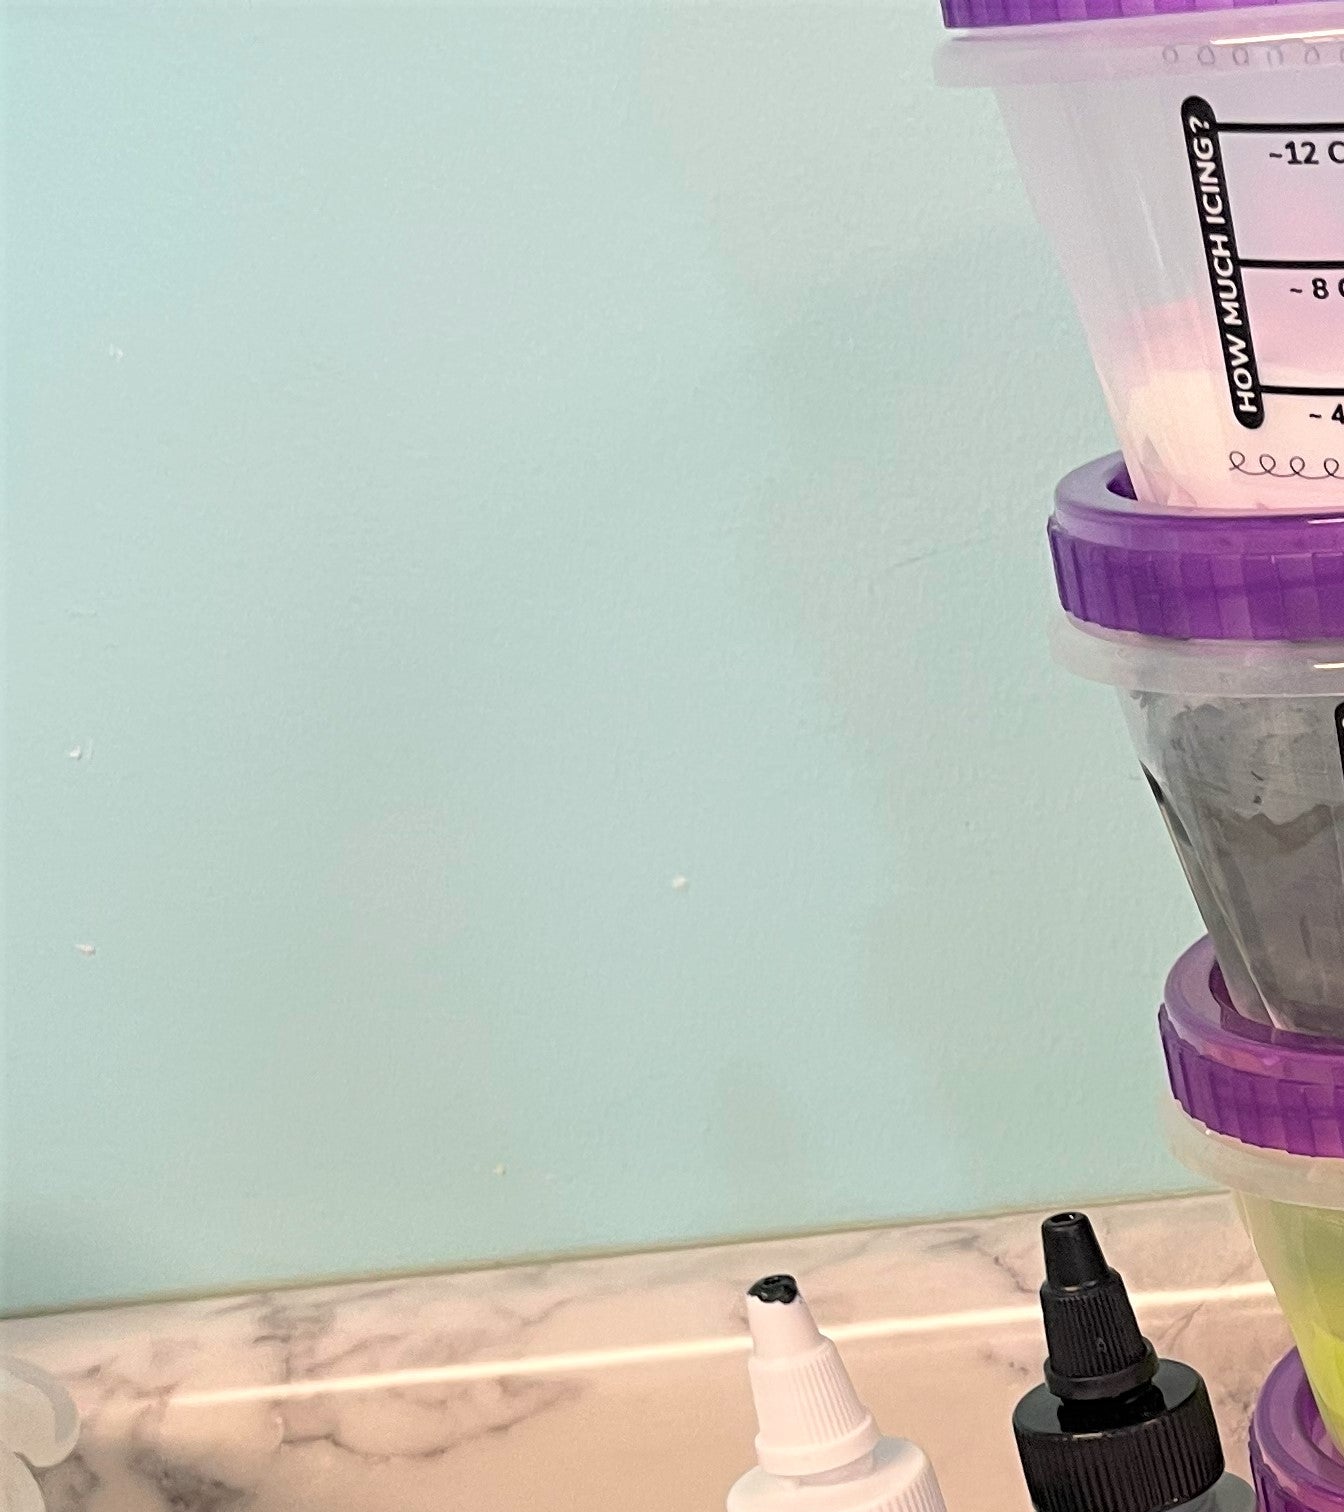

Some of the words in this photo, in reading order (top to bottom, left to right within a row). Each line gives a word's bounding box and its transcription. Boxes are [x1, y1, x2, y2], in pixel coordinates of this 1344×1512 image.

[1188, 115, 1225, 224] ICING?
[1210, 234, 1243, 326] MUCH
[1312, 277, 1330, 301] 8
[1227, 334, 1258, 412] HOW
